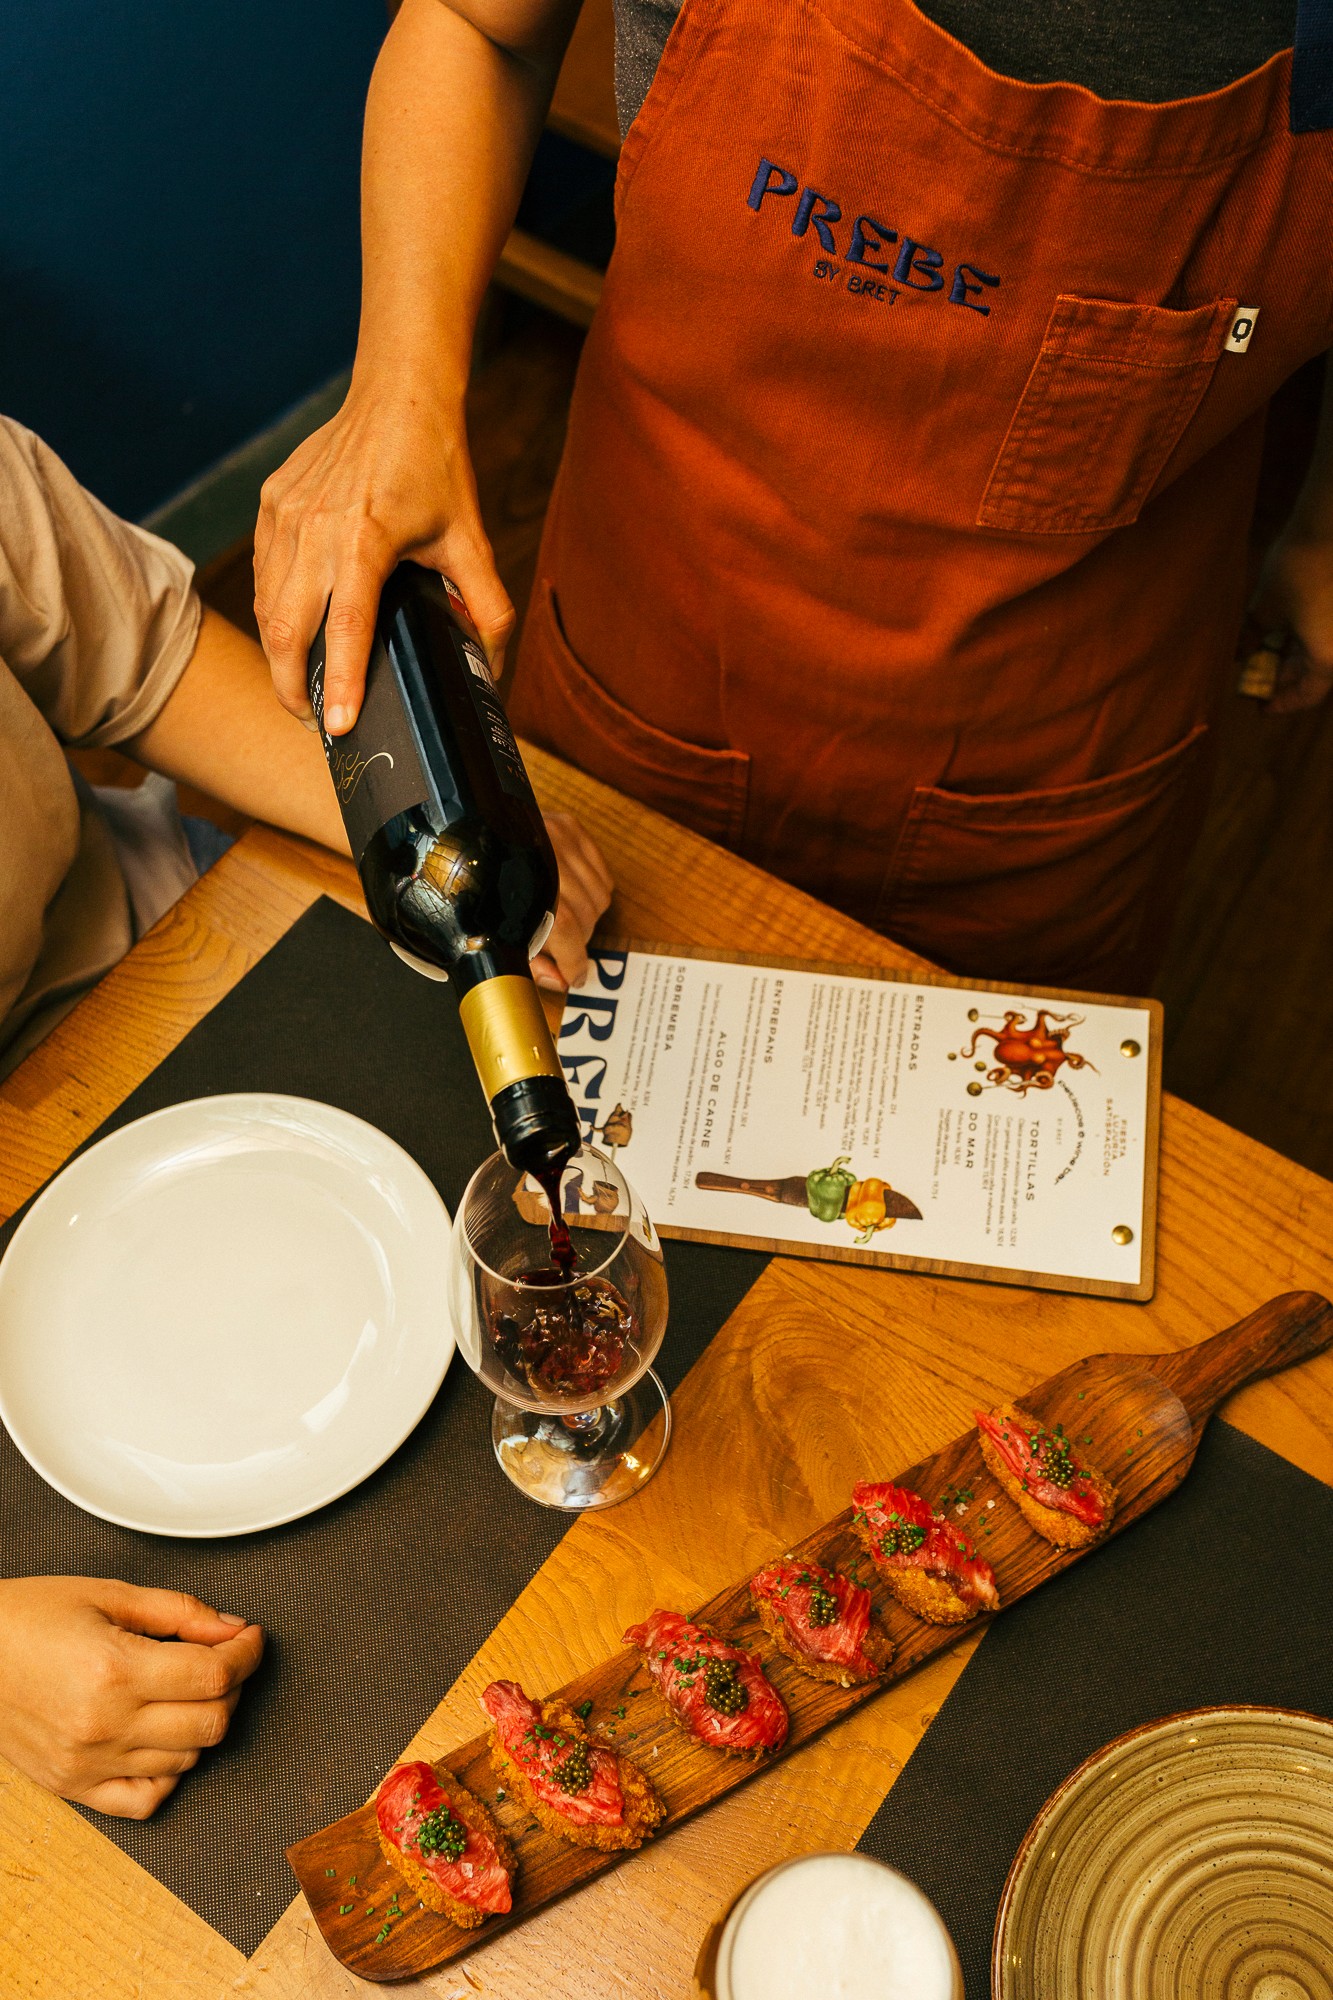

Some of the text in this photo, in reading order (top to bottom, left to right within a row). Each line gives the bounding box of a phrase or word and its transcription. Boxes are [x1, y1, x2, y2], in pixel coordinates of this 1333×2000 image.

[747, 158, 1000, 317] PREBE
[813, 260, 900, 305] BY BRET
[662, 965, 688, 1052] SOBREMESA
[762, 979, 784, 1064] ENTREPANS
[907, 994, 925, 1071] ENTRADAS
[713, 1031, 728, 1068] ALGO
[709, 1073, 721, 1092] DE
[699, 1097, 717, 1149] CARNE
[964, 1111, 978, 1169] DO MAR
[1024, 1119, 1039, 1201] TORTILLAS
[1054, 1167, 1071, 1185] bar
[1069, 1141, 1082, 1166] wine
